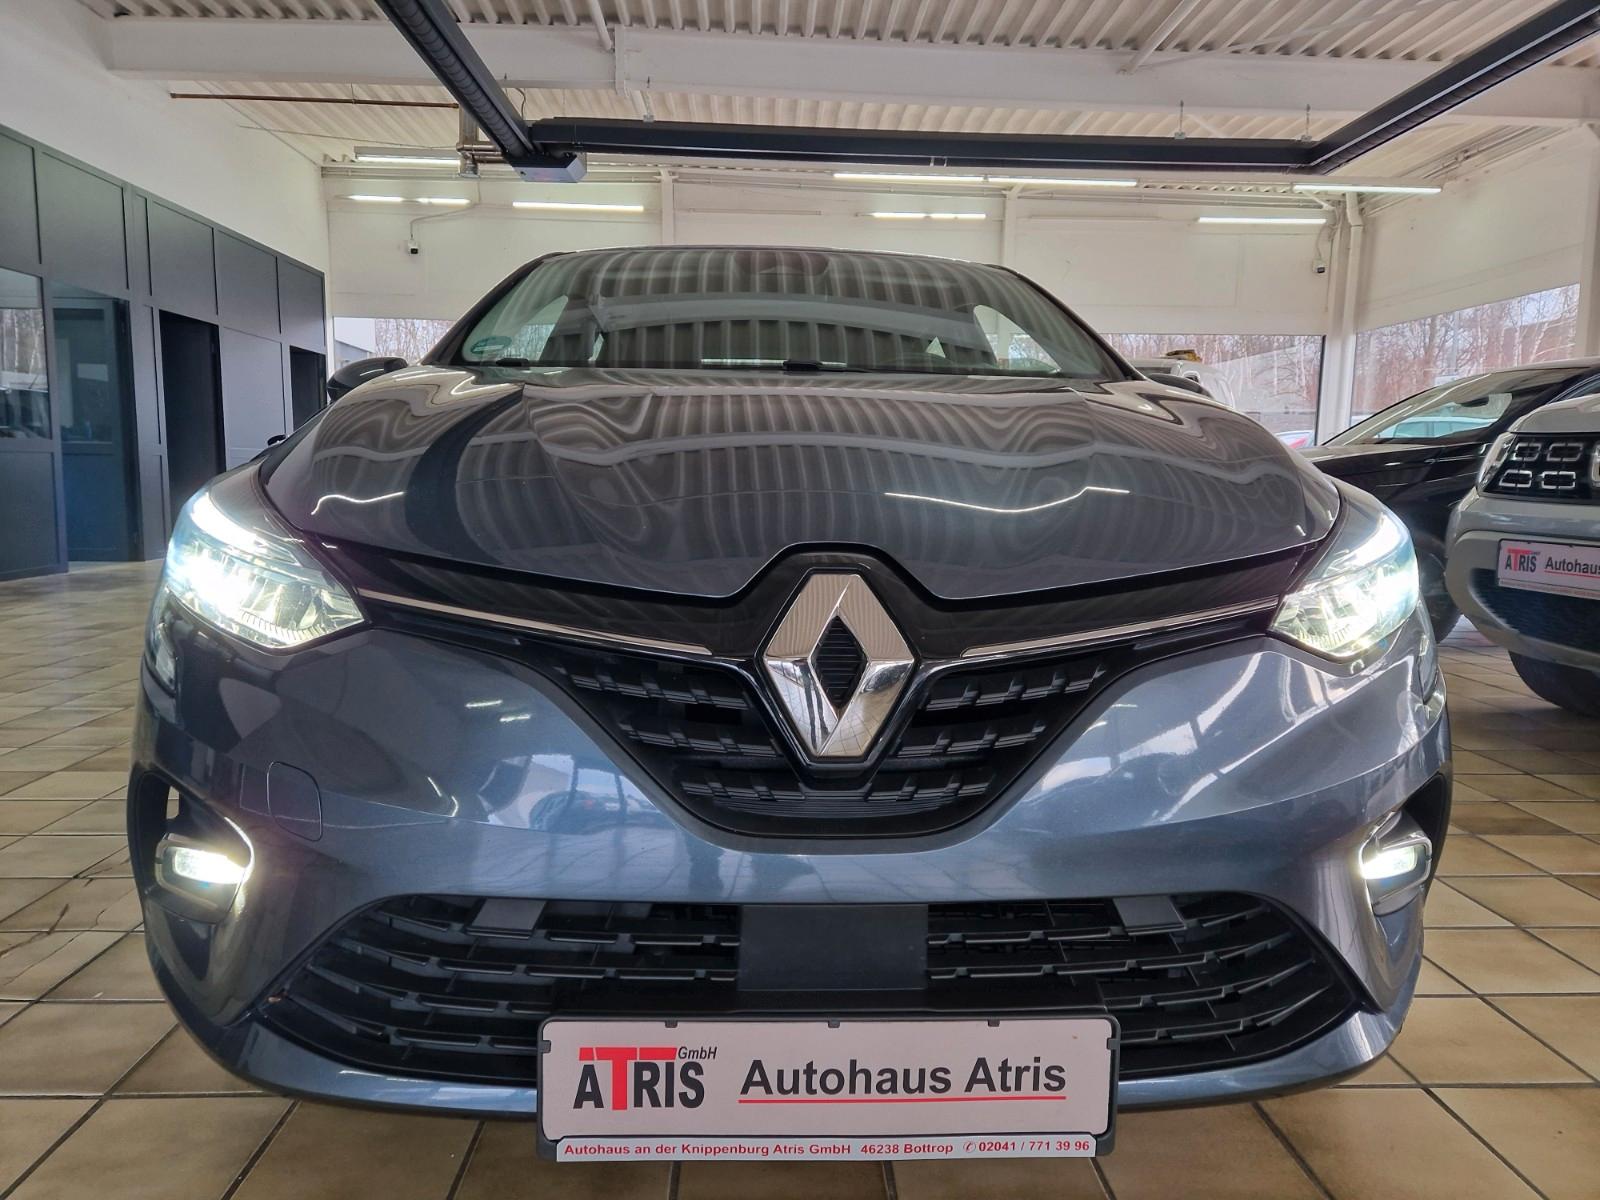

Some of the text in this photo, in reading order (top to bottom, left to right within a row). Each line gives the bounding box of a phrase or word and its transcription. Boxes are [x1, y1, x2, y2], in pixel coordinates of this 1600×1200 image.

[1505, 548, 1536, 572] ATRIS
[678, 1047, 717, 1060] GmbH
[573, 1047, 705, 1111] ATRIS
[740, 1056, 1066, 1095] Autohaus Atris
[564, 1144, 630, 1155] Autohaus
[635, 1146, 650, 1154] an
[655, 1144, 677, 1154] der
[681, 1144, 769, 1156] Knippenburg
[773, 1143, 805, 1154] Atris
[809, 1143, 851, 1154] GmbH
[860, 1143, 899, 1154] 46238
[904, 1143, 953, 1154] Bottrop
[979, 1141, 1016, 1152] 02041
[1029, 1141, 1050, 1151] 771
[1056, 1141, 1070, 1151] 39
[1074, 1140, 1090, 1151] 96
